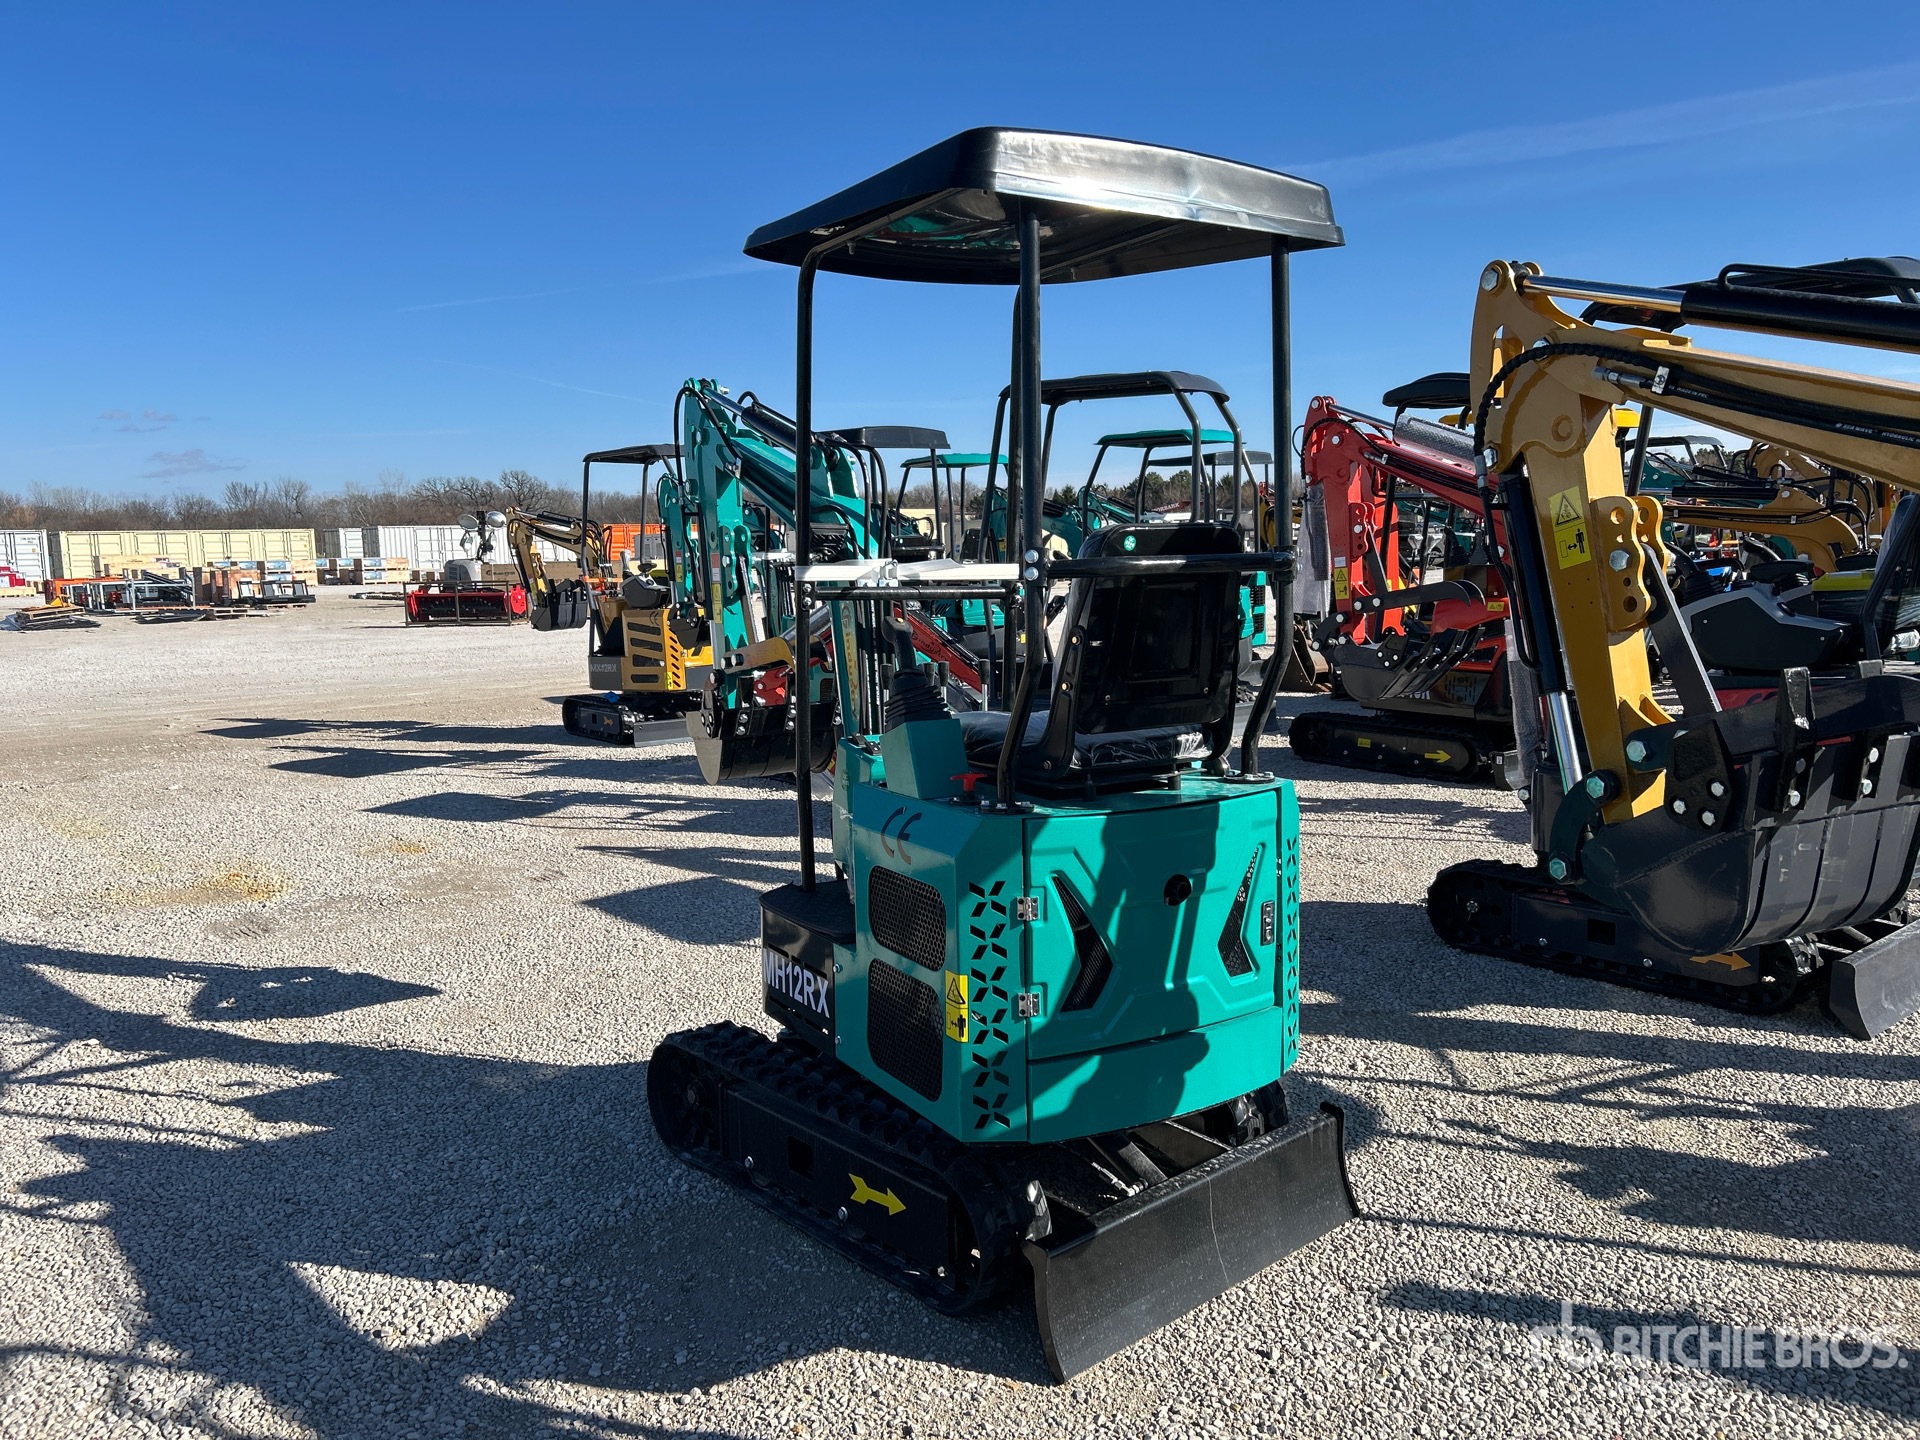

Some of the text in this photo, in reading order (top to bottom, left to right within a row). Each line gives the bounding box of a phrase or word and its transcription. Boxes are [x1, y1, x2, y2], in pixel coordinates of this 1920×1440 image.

[1882, 432, 1915, 442] HYDRAULIC
[880, 806, 923, 866] CE
[763, 948, 830, 1018] MH12RX
